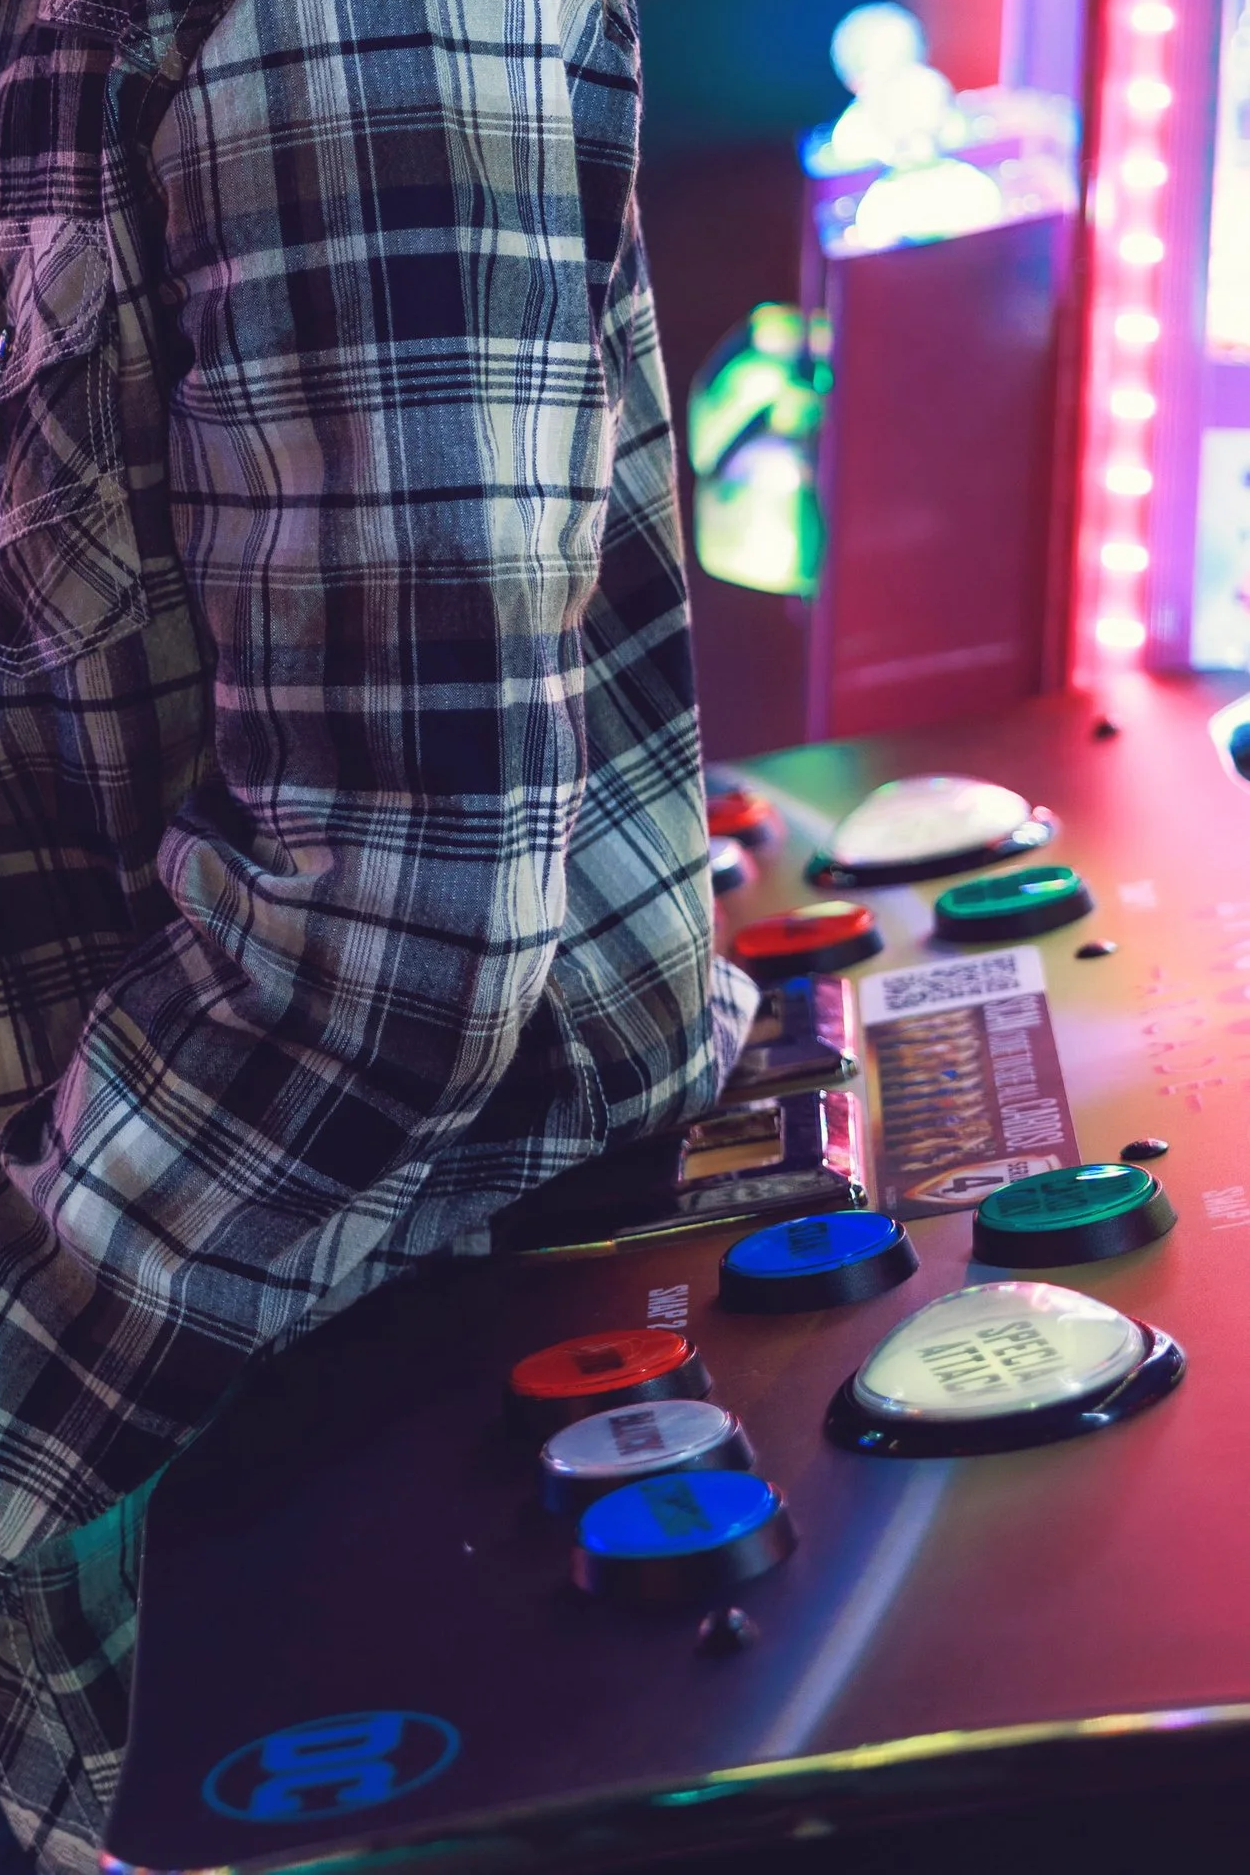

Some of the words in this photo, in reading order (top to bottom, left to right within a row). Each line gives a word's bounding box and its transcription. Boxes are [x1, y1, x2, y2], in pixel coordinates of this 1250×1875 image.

[983, 994, 1044, 1032] SCAN
[988, 1028, 1031, 1058] CODE
[997, 1081, 1040, 1106] ALL
[1000, 1097, 1065, 1152] CARDS!
[942, 1176, 1004, 1194] 4
[1201, 1186, 1250, 1220] SWAP
[646, 1284, 690, 1318] SWAP
[915, 1339, 1012, 1399] ATTACK
[976, 1320, 1070, 1388] SPECIA
